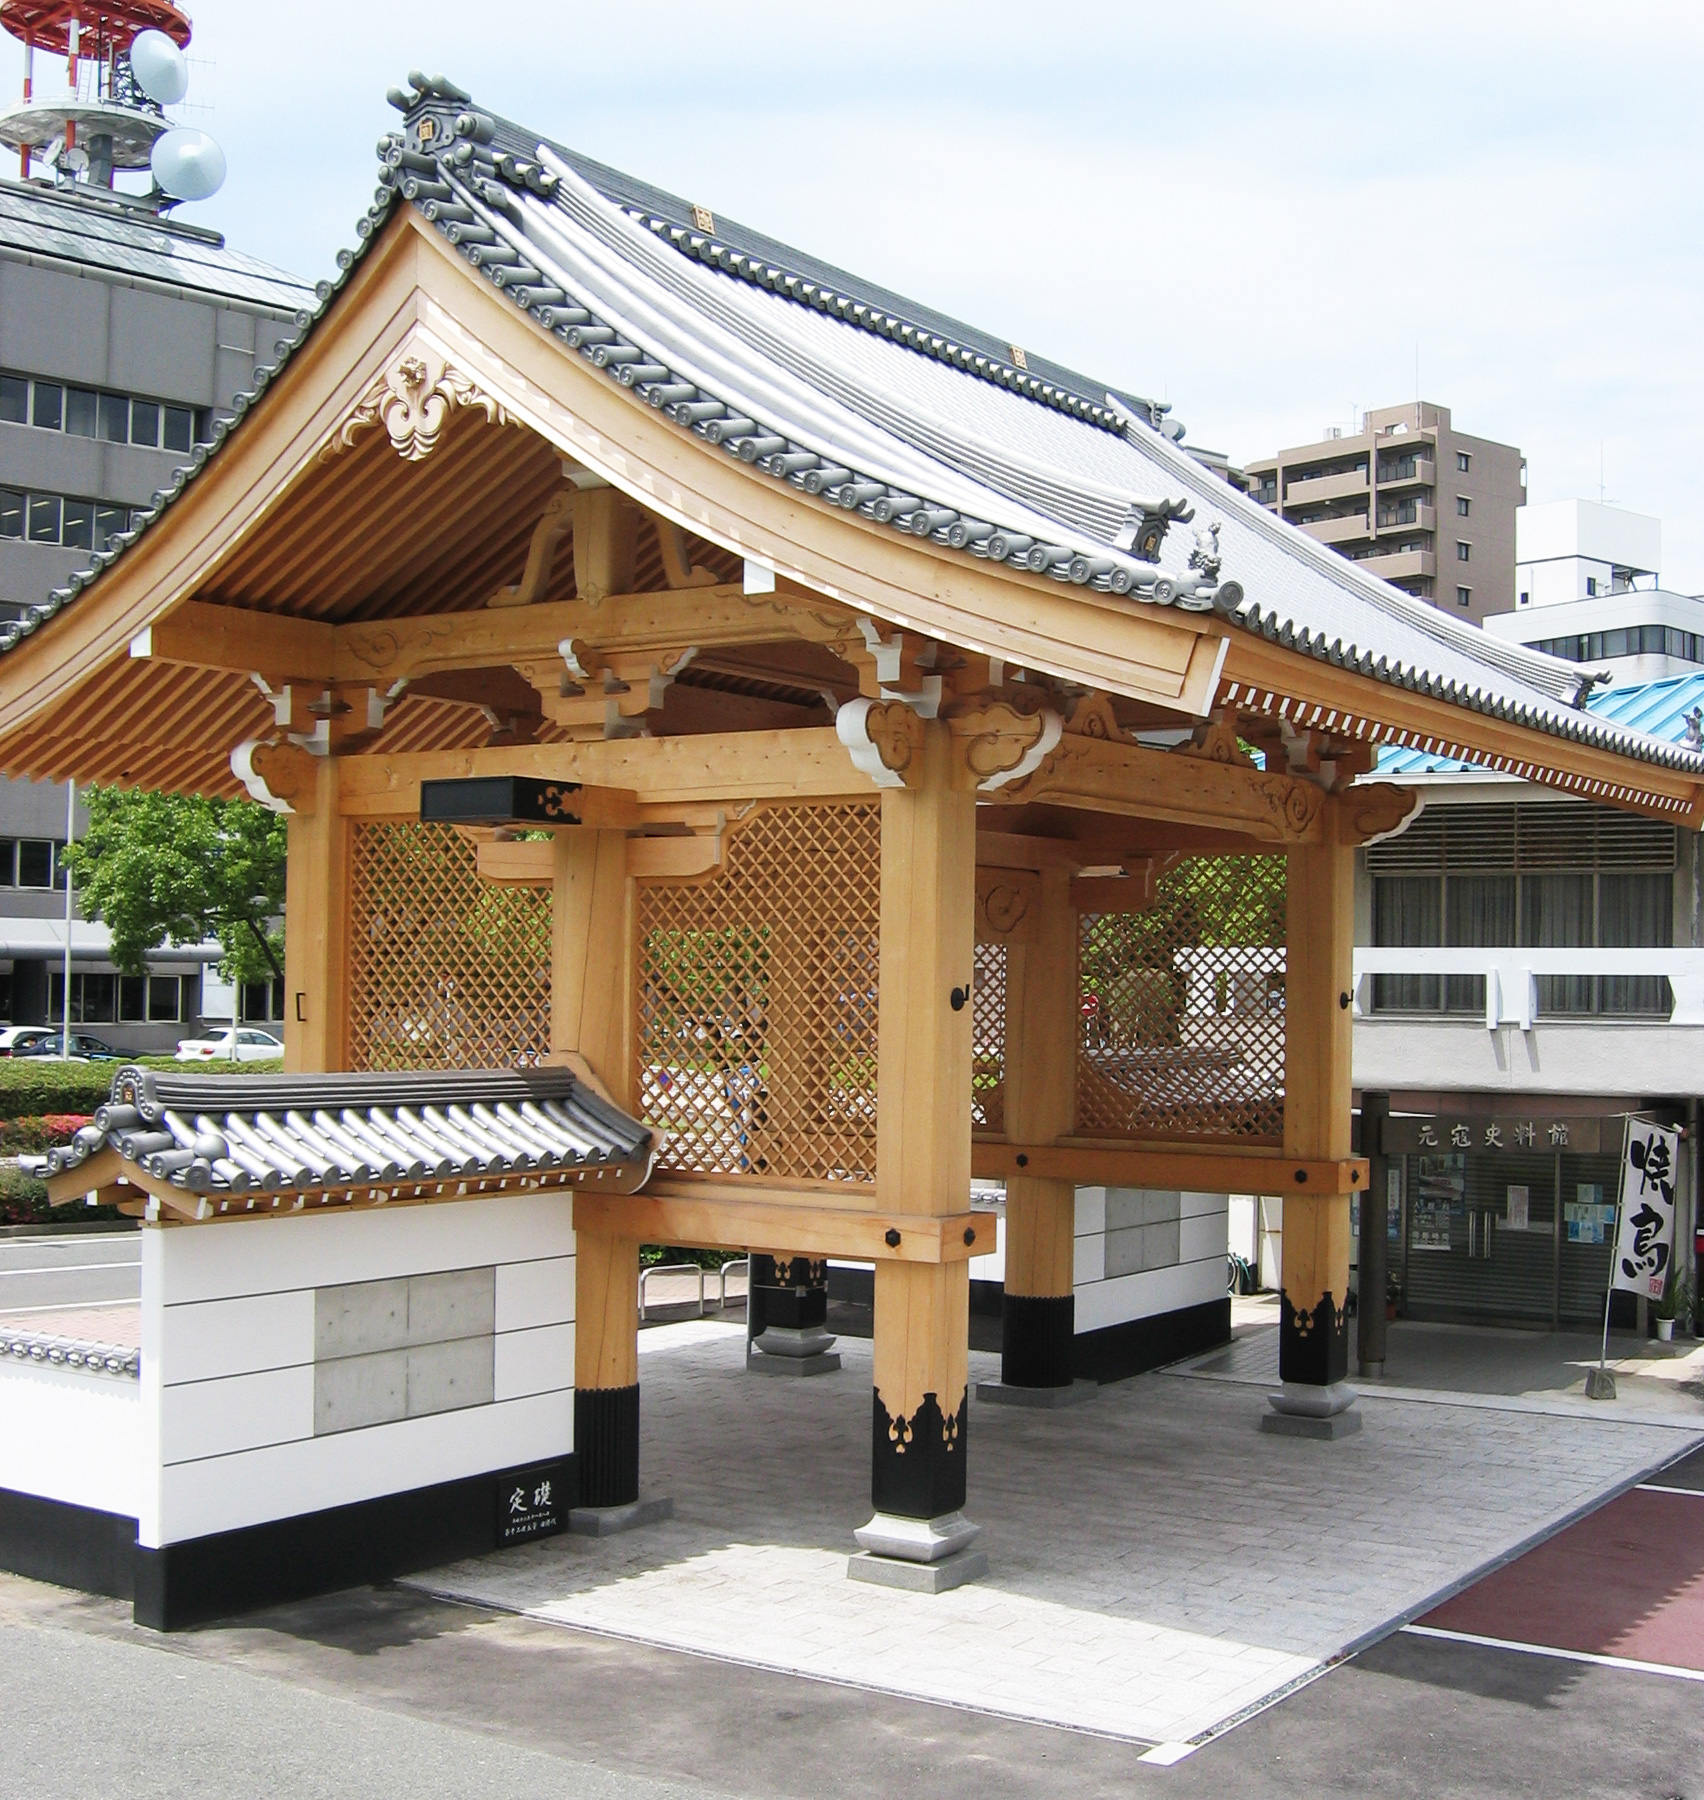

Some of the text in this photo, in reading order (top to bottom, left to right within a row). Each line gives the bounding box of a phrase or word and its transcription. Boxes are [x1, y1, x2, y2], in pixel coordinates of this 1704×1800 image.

[1417, 1121, 1569, 1148] 元寇史料館
[1621, 1132, 1675, 1279] 焼鳥
[509, 1480, 553, 1514] 定礎
